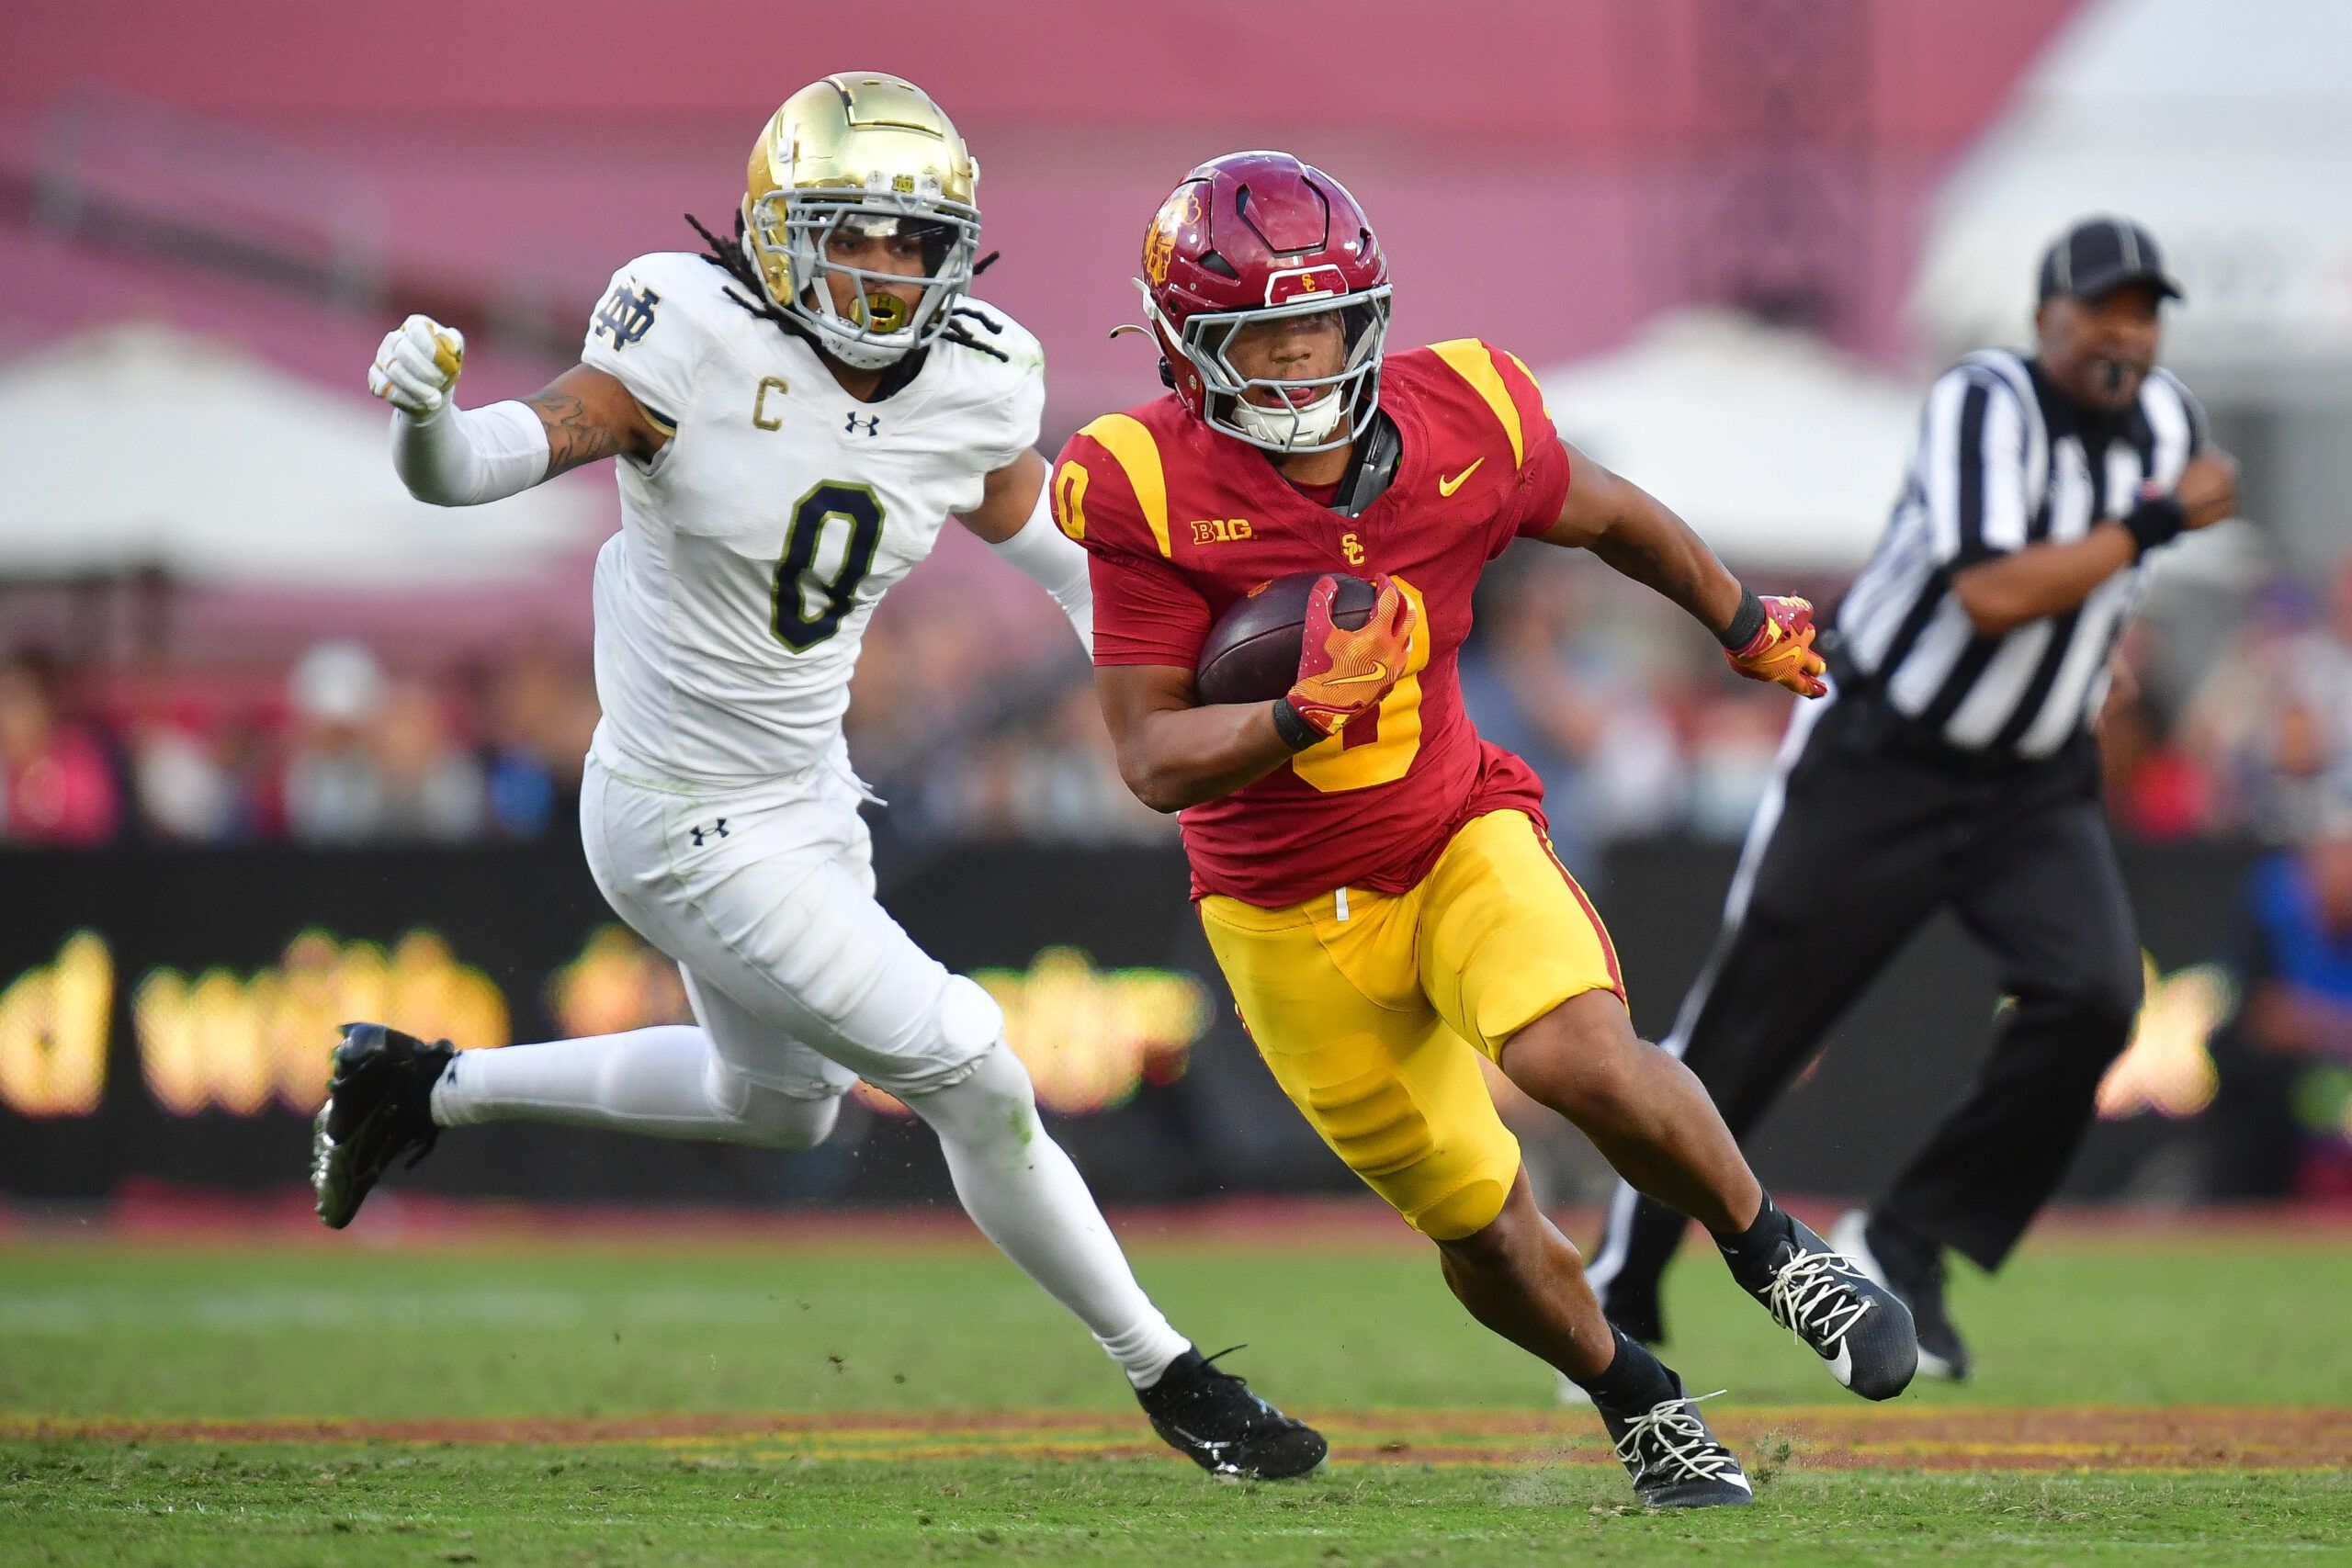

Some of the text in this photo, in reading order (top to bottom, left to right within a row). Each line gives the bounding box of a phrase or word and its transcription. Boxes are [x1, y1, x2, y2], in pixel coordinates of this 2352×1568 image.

[1301, 273, 1317, 292] SC
[752, 376, 789, 432] C
[1056, 459, 1090, 540] 0
[770, 479, 886, 654] 0
[1341, 533, 1366, 566] SC
